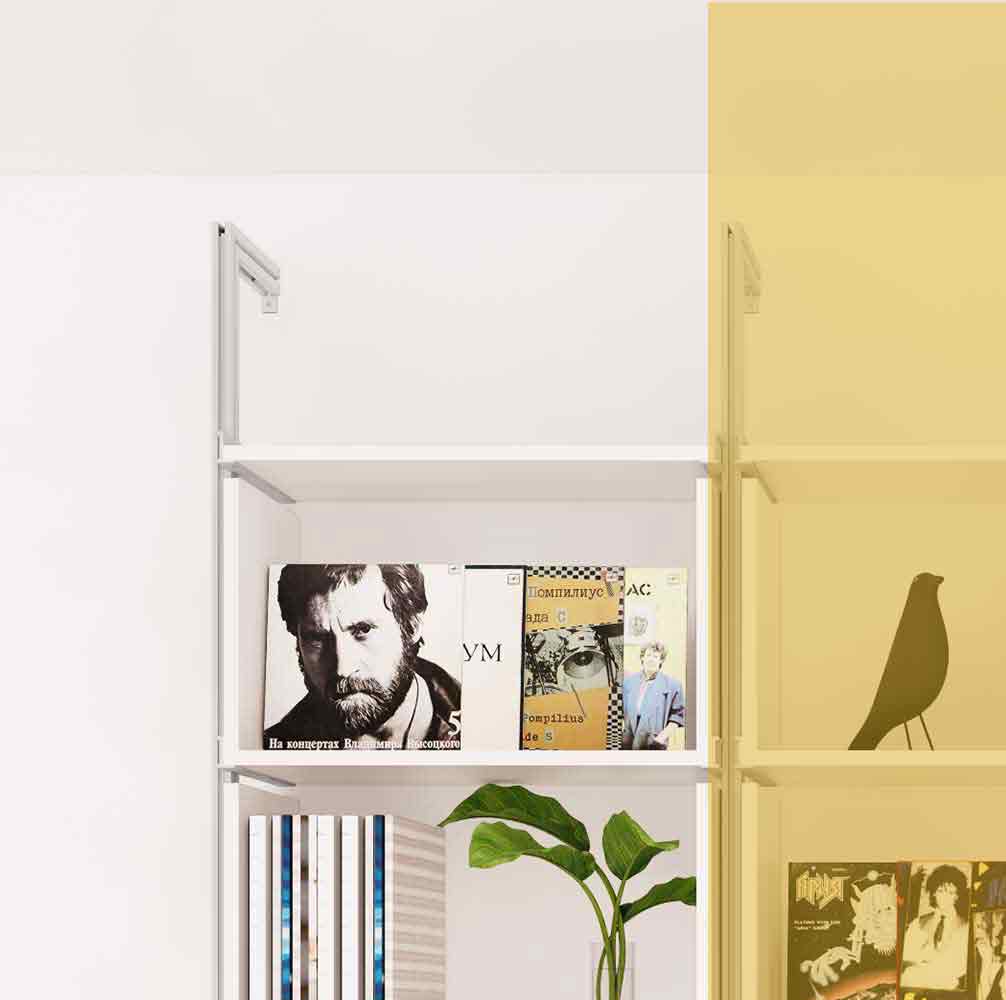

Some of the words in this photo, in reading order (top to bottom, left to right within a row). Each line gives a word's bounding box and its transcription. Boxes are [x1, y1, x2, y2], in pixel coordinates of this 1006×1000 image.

[528, 585, 604, 600] Помпилиус
[448, 710, 461, 740] 5
[269, 737, 284, 749] На
[286, 740, 340, 751] концертах
